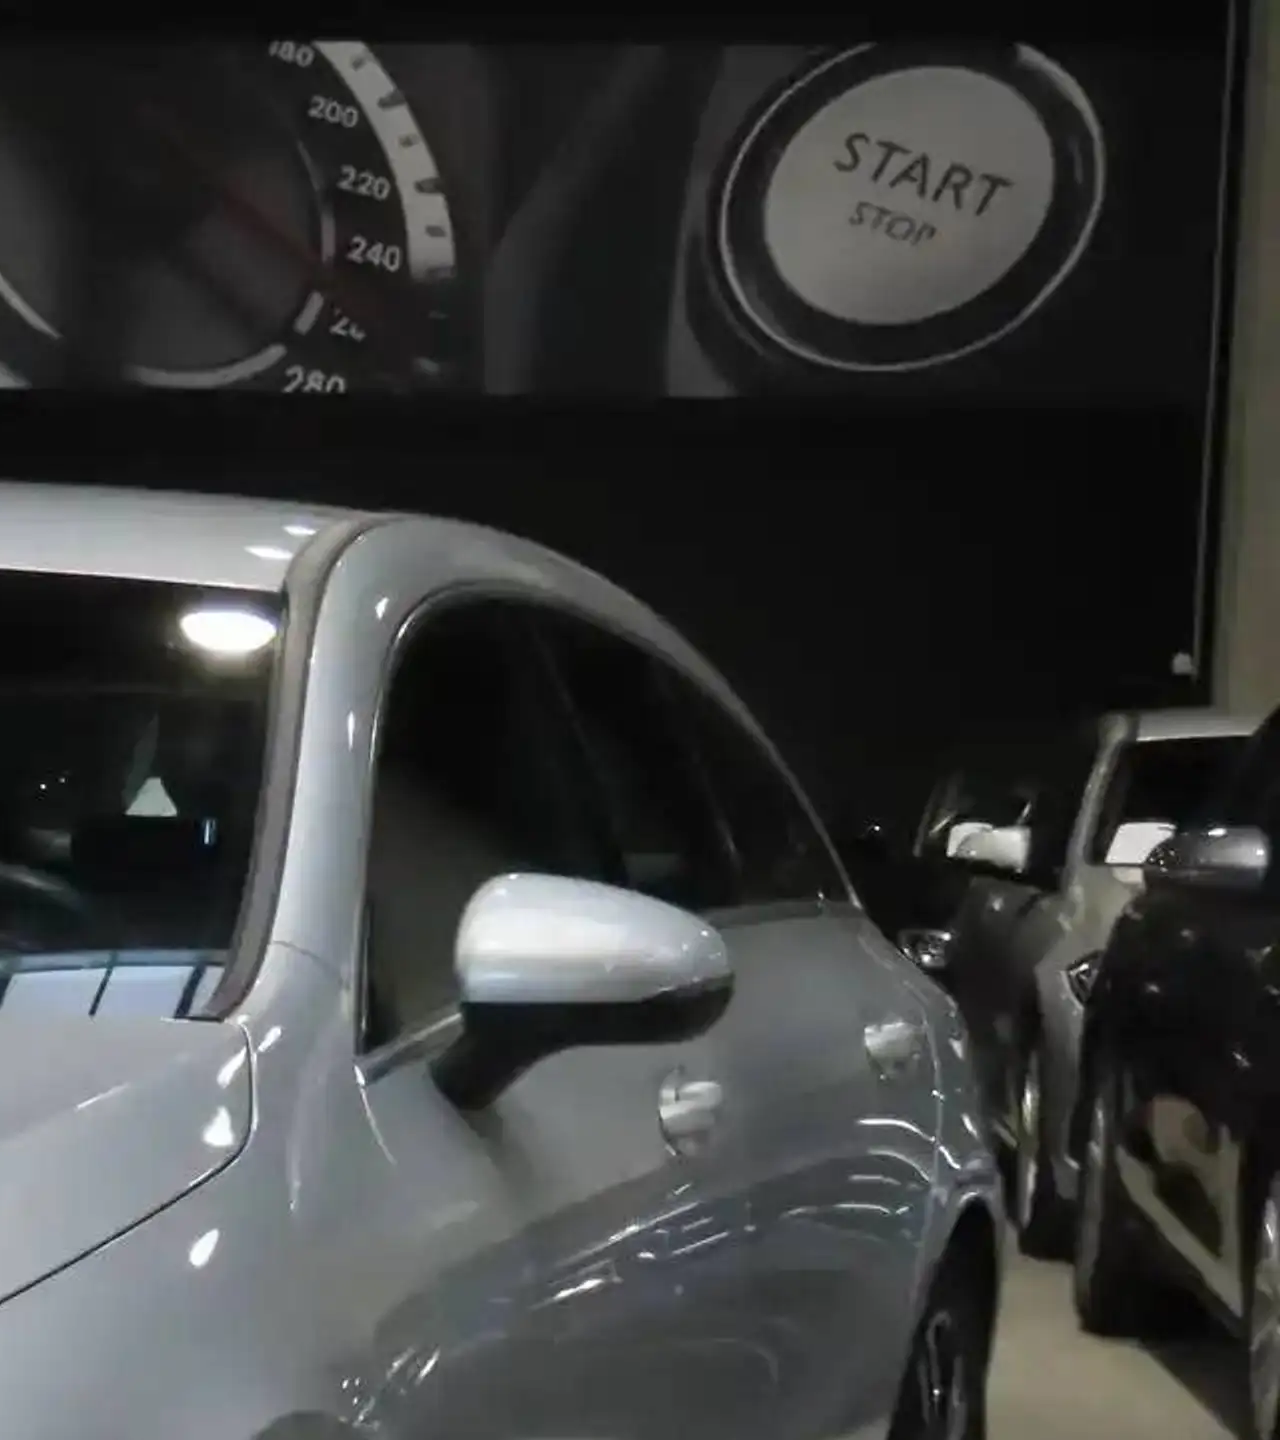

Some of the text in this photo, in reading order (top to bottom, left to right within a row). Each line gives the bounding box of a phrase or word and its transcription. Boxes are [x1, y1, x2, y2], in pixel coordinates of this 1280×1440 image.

[308, 95, 359, 128] 200
[337, 165, 391, 199] 220
[833, 132, 1014, 216] START
[848, 200, 937, 246] STOP
[347, 235, 401, 271] 240
